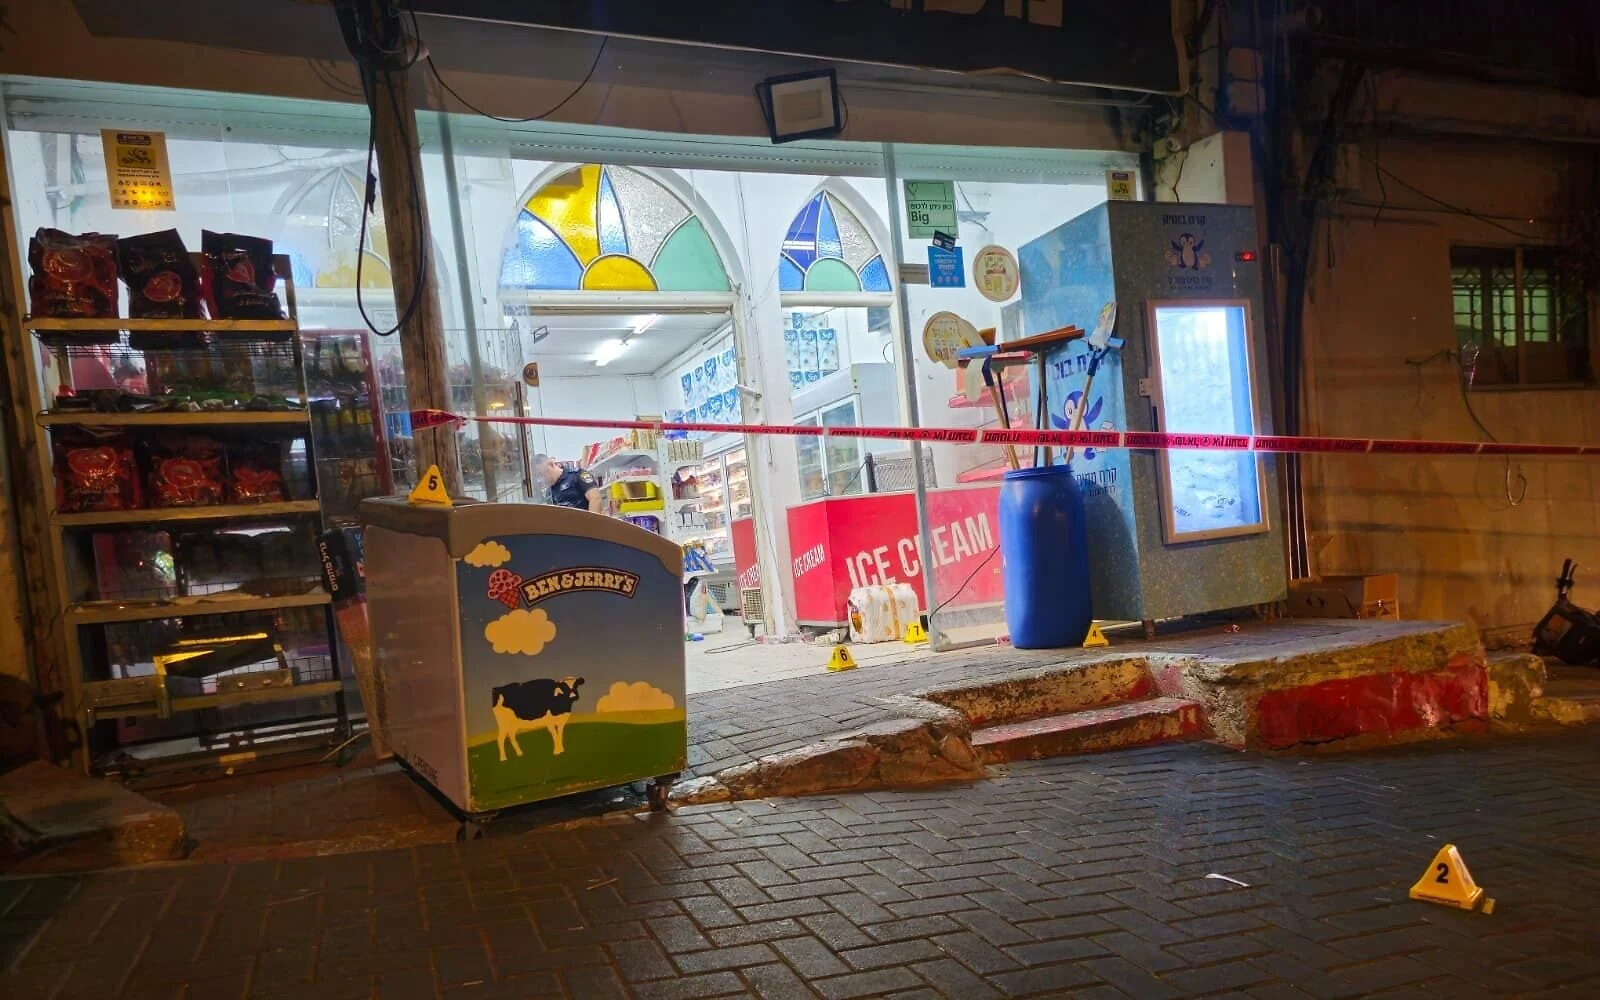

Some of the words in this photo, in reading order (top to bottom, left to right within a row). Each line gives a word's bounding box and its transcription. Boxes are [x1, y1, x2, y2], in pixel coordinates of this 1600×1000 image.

[912, 210, 930, 224] Big
[1172, 436, 1199, 448] ישראל
[428, 476, 438, 490] 5
[794, 554, 804, 577] ICE
[804, 544, 825, 572] CREAM
[846, 545, 896, 588] ICE
[914, 626, 918, 636] 7
[840, 649, 848, 661] 6
[1436, 863, 1449, 884] 2
